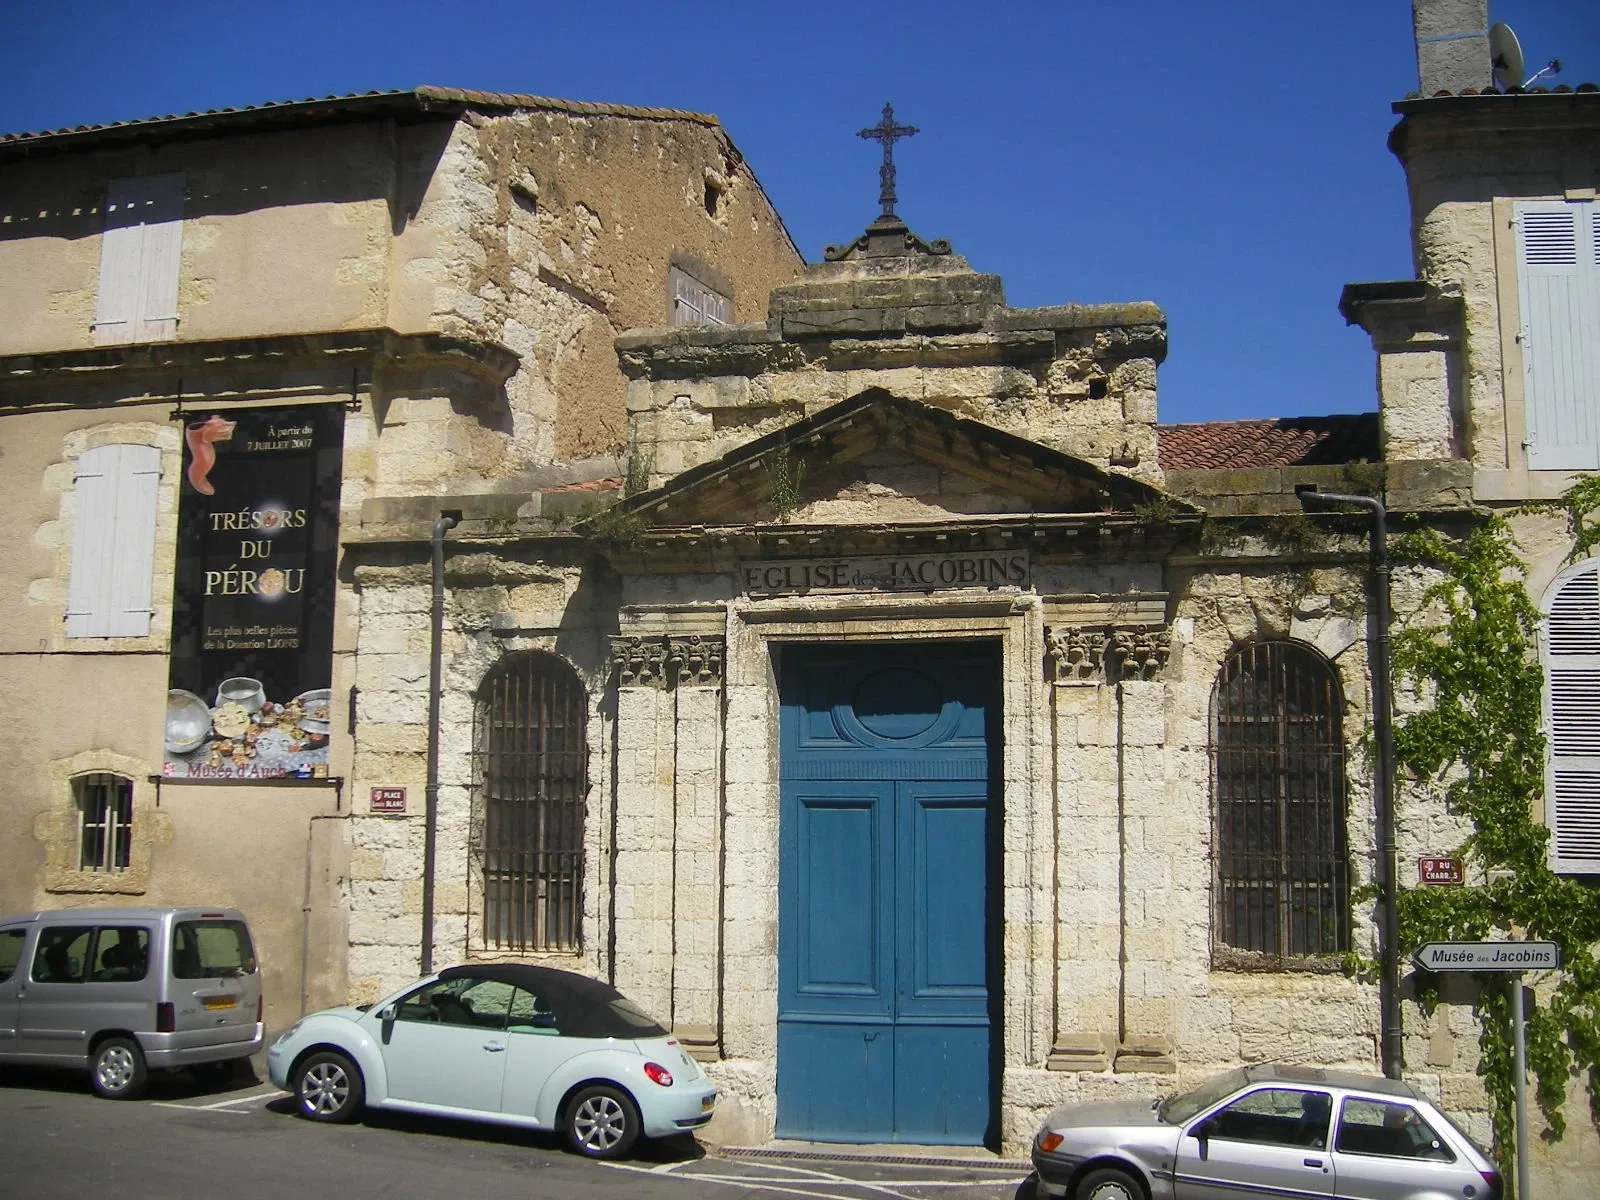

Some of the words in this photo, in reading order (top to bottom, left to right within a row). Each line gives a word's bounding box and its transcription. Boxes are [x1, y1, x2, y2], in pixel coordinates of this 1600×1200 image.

[255, 440, 290, 451] JUILLET
[291, 438, 312, 449] 2007
[209, 507, 307, 531] TRÉSORS
[240, 540, 272, 559] DU
[887, 556, 1027, 587] JACOBINS
[203, 564, 306, 597] PÉROU
[267, 638, 299, 649] LIONS
[187, 763, 233, 778] Musée
[1426, 872, 1458, 880] CHARRS
[1432, 950, 1474, 962] Musée
[1477, 955, 1489, 963] des
[1492, 950, 1550, 962] Jacobins
